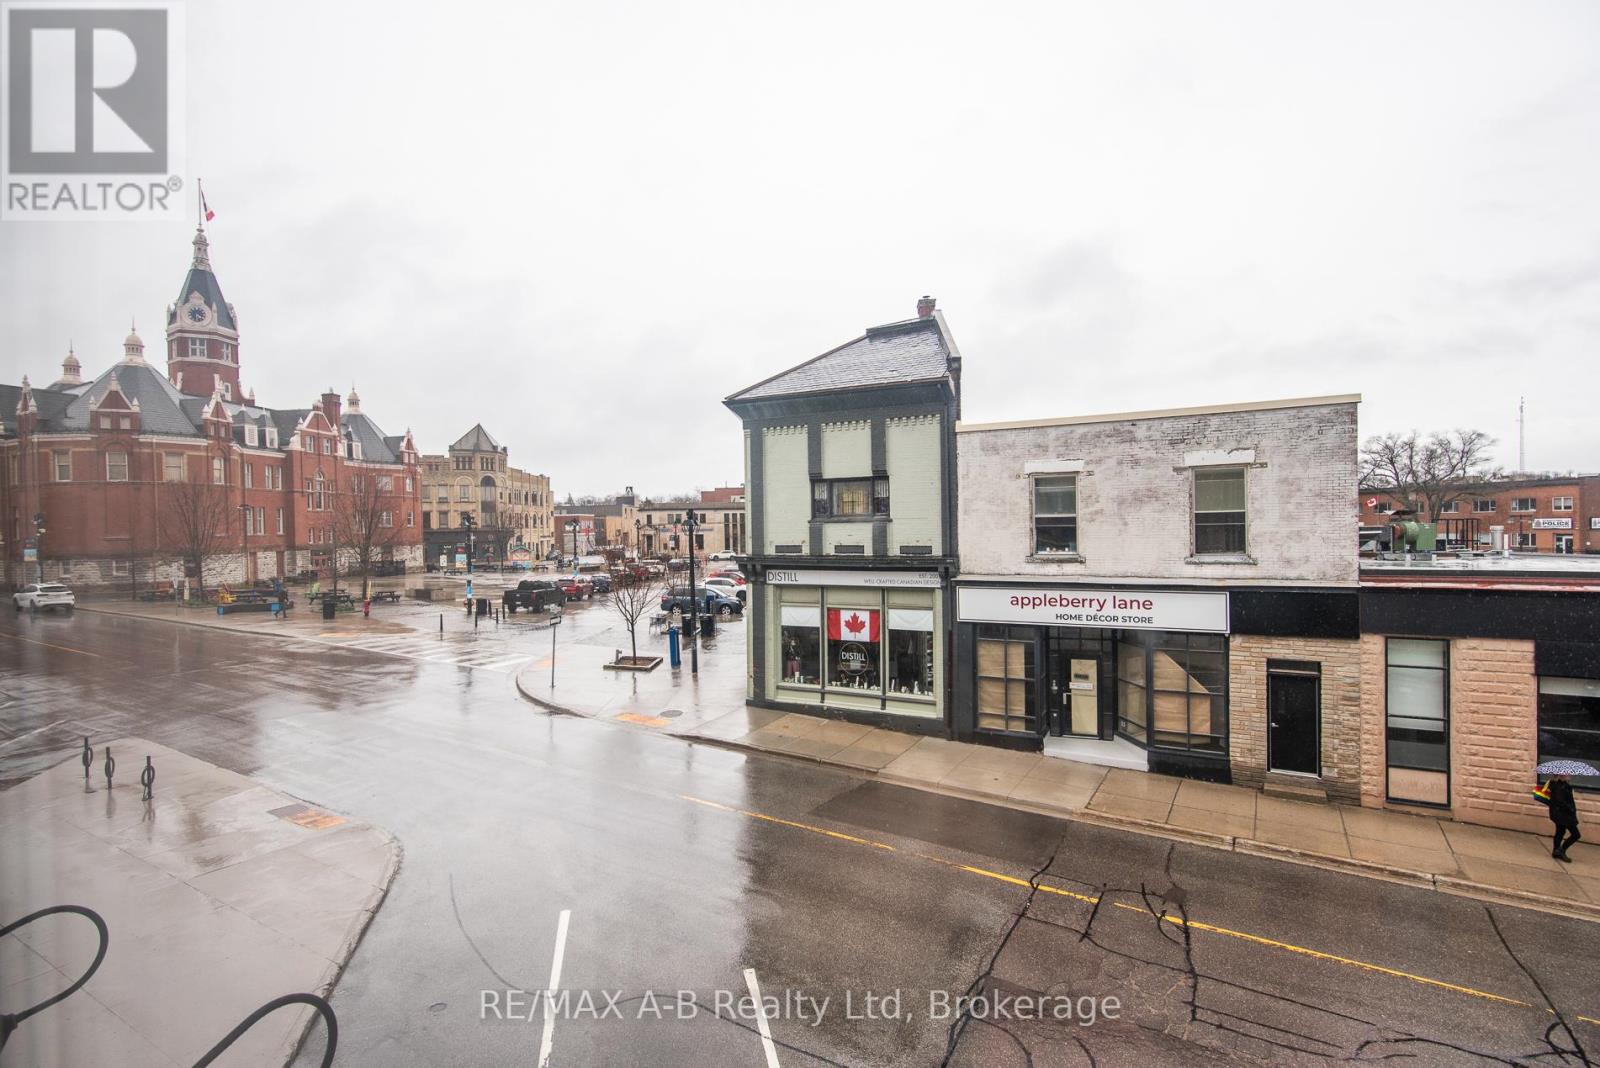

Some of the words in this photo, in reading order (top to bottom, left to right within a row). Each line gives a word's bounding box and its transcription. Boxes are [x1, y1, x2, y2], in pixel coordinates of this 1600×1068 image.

[767, 571, 799, 582] DISTILL
[1010, 593, 1107, 612] appleberry
[1112, 595, 1154, 610] lane
[1055, 613, 1083, 622] HOME
[1085, 612, 1119, 623] DÉCOR
[1121, 615, 1154, 624] STORE
[841, 651, 866, 661] DISTILL
